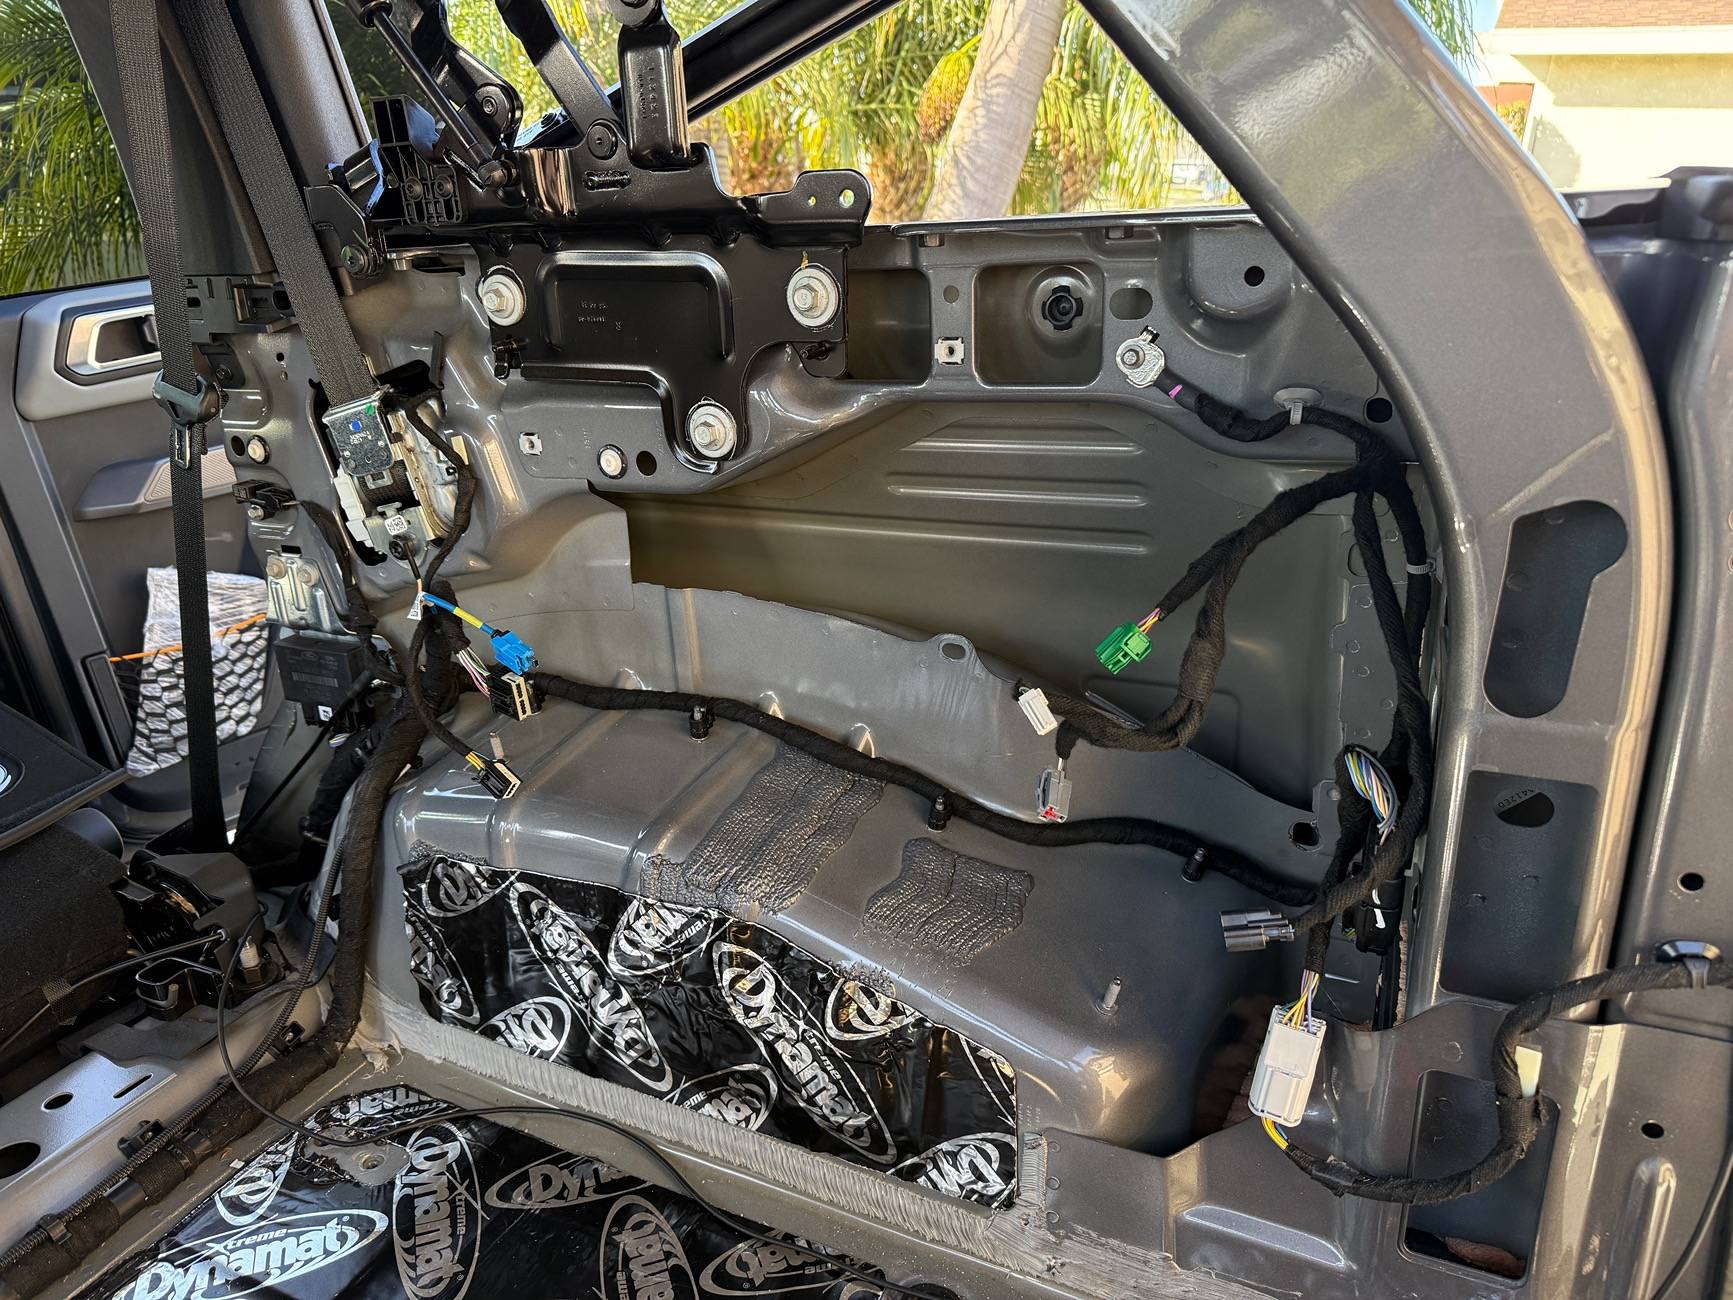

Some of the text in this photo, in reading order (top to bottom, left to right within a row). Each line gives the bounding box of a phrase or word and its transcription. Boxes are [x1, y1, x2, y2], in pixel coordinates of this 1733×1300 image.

[201, 1220, 289, 1258] Xtreme
[401, 1141, 465, 1288] Dynamat
[133, 1217, 342, 1300] Dynamat
